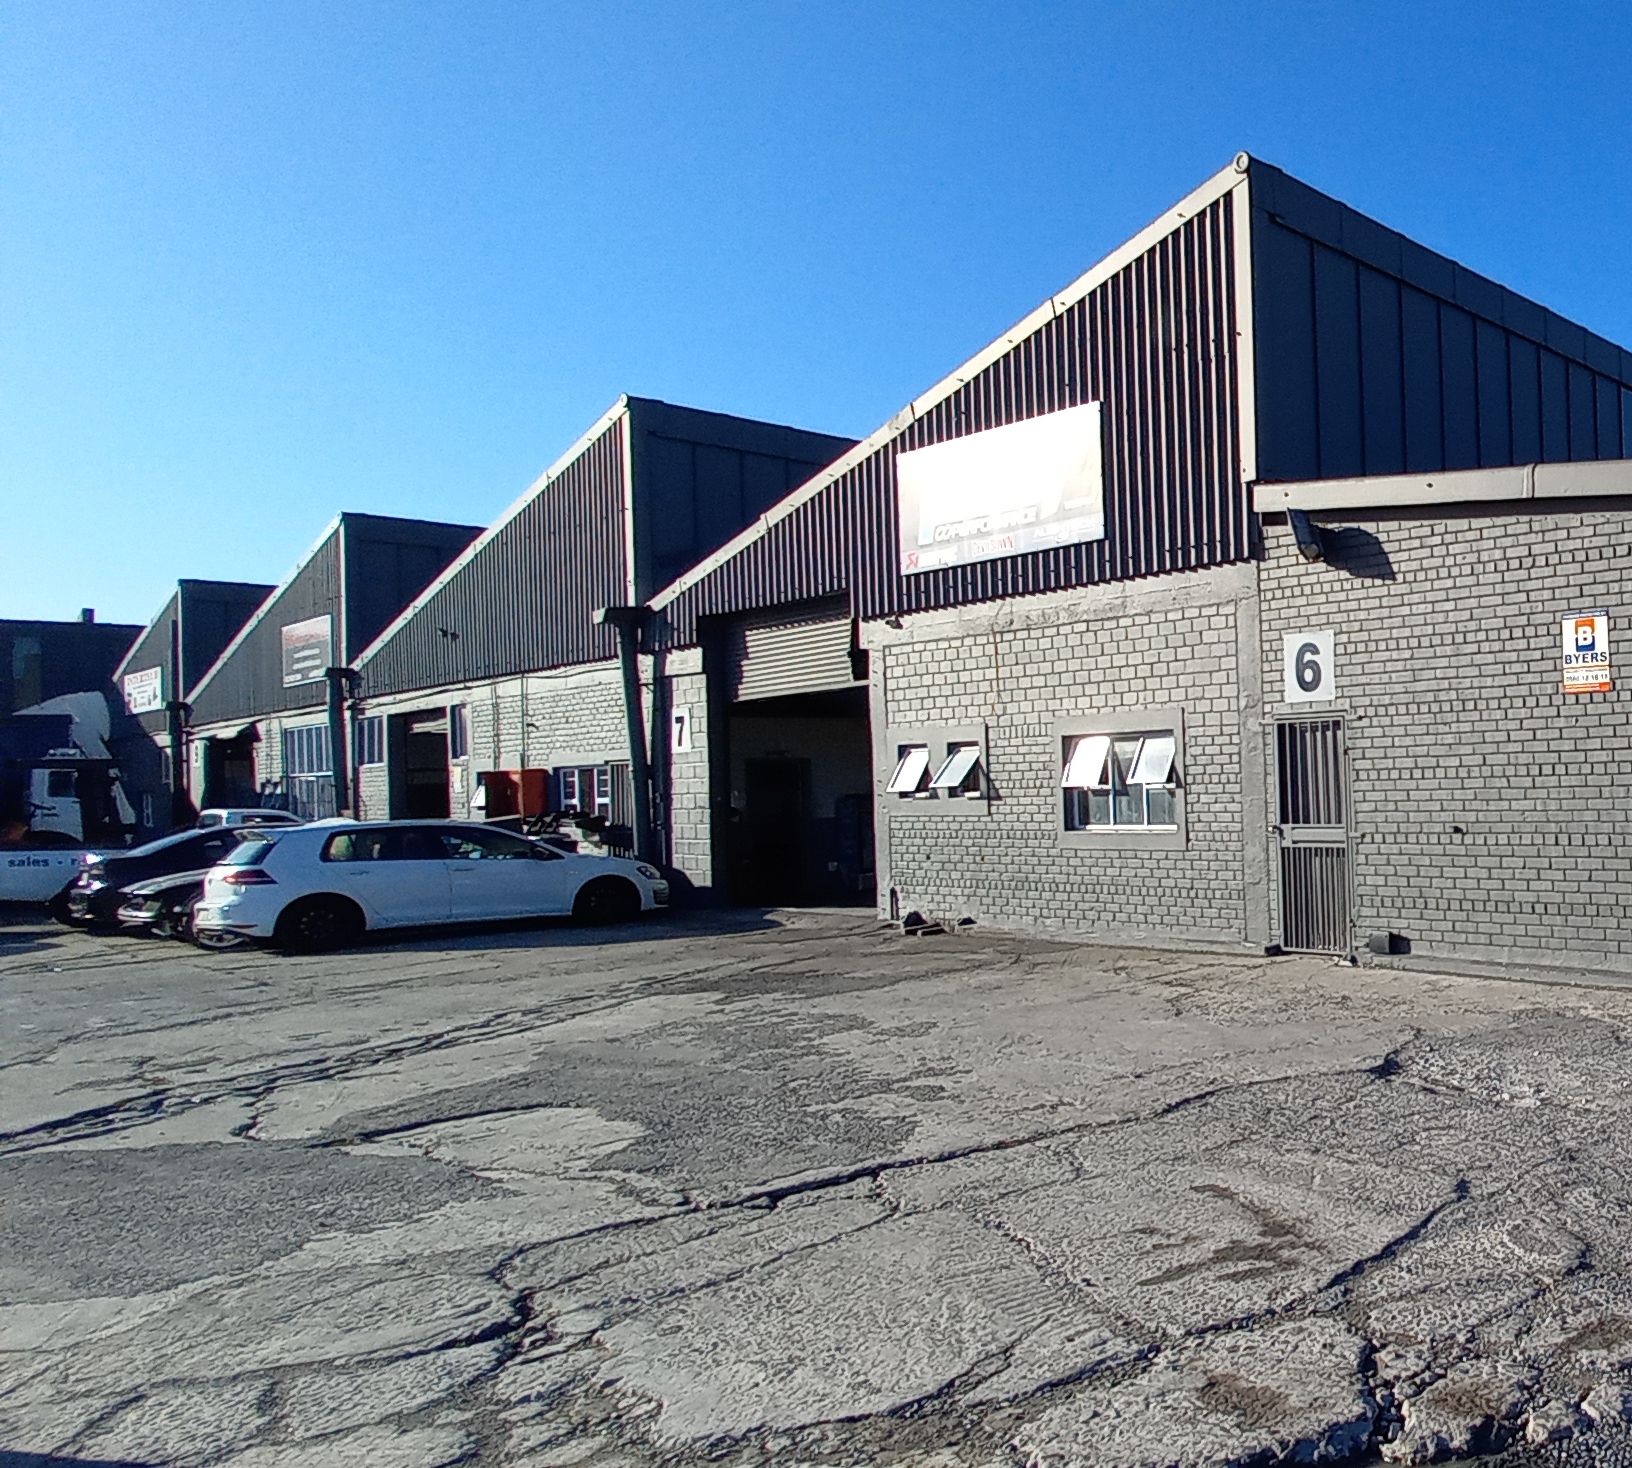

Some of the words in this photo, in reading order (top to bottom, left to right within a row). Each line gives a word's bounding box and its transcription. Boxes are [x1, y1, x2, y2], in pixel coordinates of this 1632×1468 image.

[1577, 626, 1593, 646] B
[1295, 641, 1322, 693] 6
[1565, 651, 1608, 665] BYERS
[674, 715, 685, 747] 7
[7, 855, 50, 868] sales
